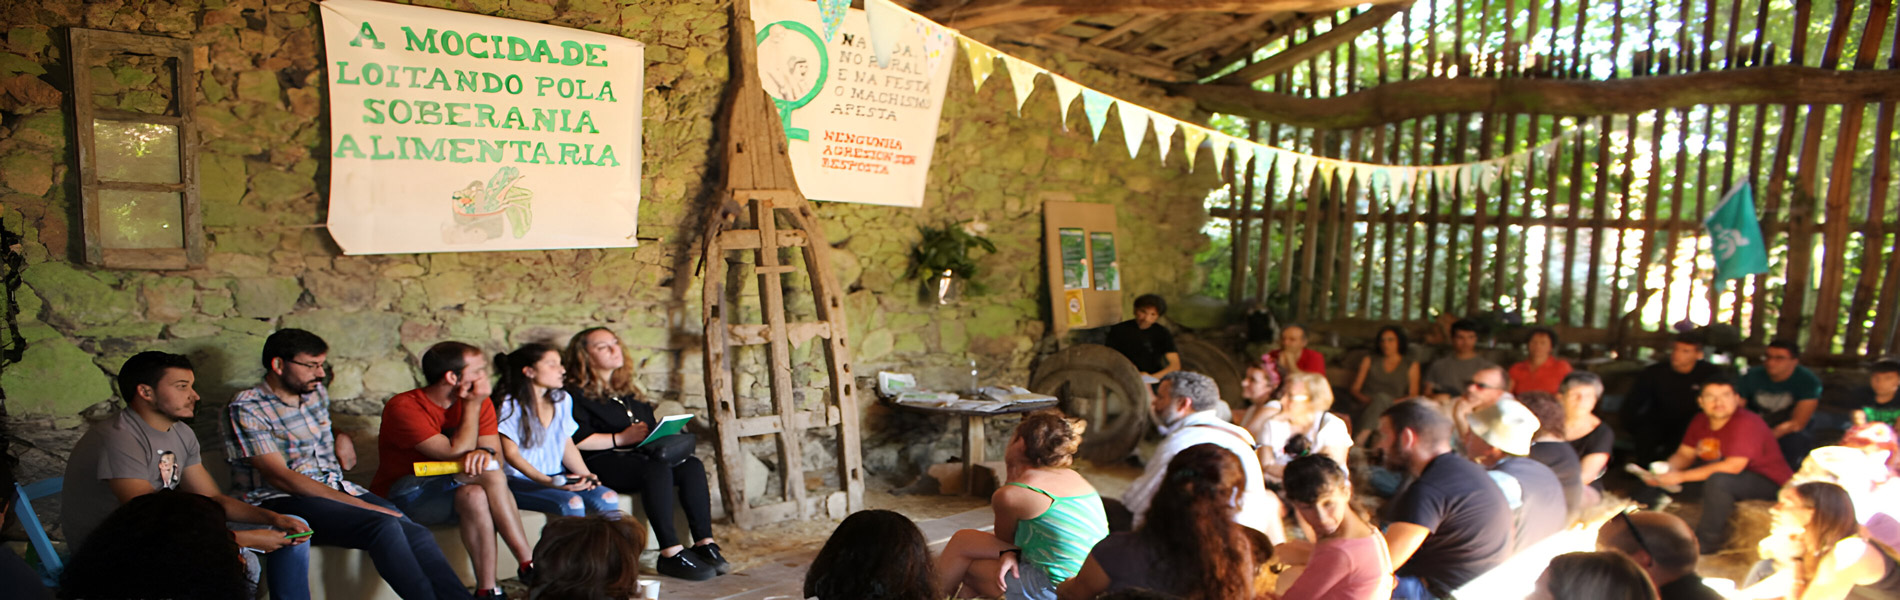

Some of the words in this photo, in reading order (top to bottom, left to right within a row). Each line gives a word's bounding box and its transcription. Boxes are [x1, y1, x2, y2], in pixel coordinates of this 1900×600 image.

[350, 21, 385, 49] A
[401, 26, 608, 67] MOCIDADE
[841, 33, 866, 49] NA
[840, 51, 862, 65] NO
[868, 55, 922, 75] RRAL
[336, 61, 523, 95] LOITANDO
[535, 76, 617, 102] POLA
[838, 68, 847, 81] E
[854, 71, 877, 86] NA
[885, 75, 931, 94] FESTA
[834, 85, 845, 97] O
[850, 87, 932, 109] MACHISMO
[362, 98, 600, 134] SOBERANIA
[830, 103, 897, 121] APESTA
[333, 134, 620, 167] ALIMENTARIA
[823, 130, 903, 150] NENGUNHA
[821, 157, 889, 175] RESPOSTA
